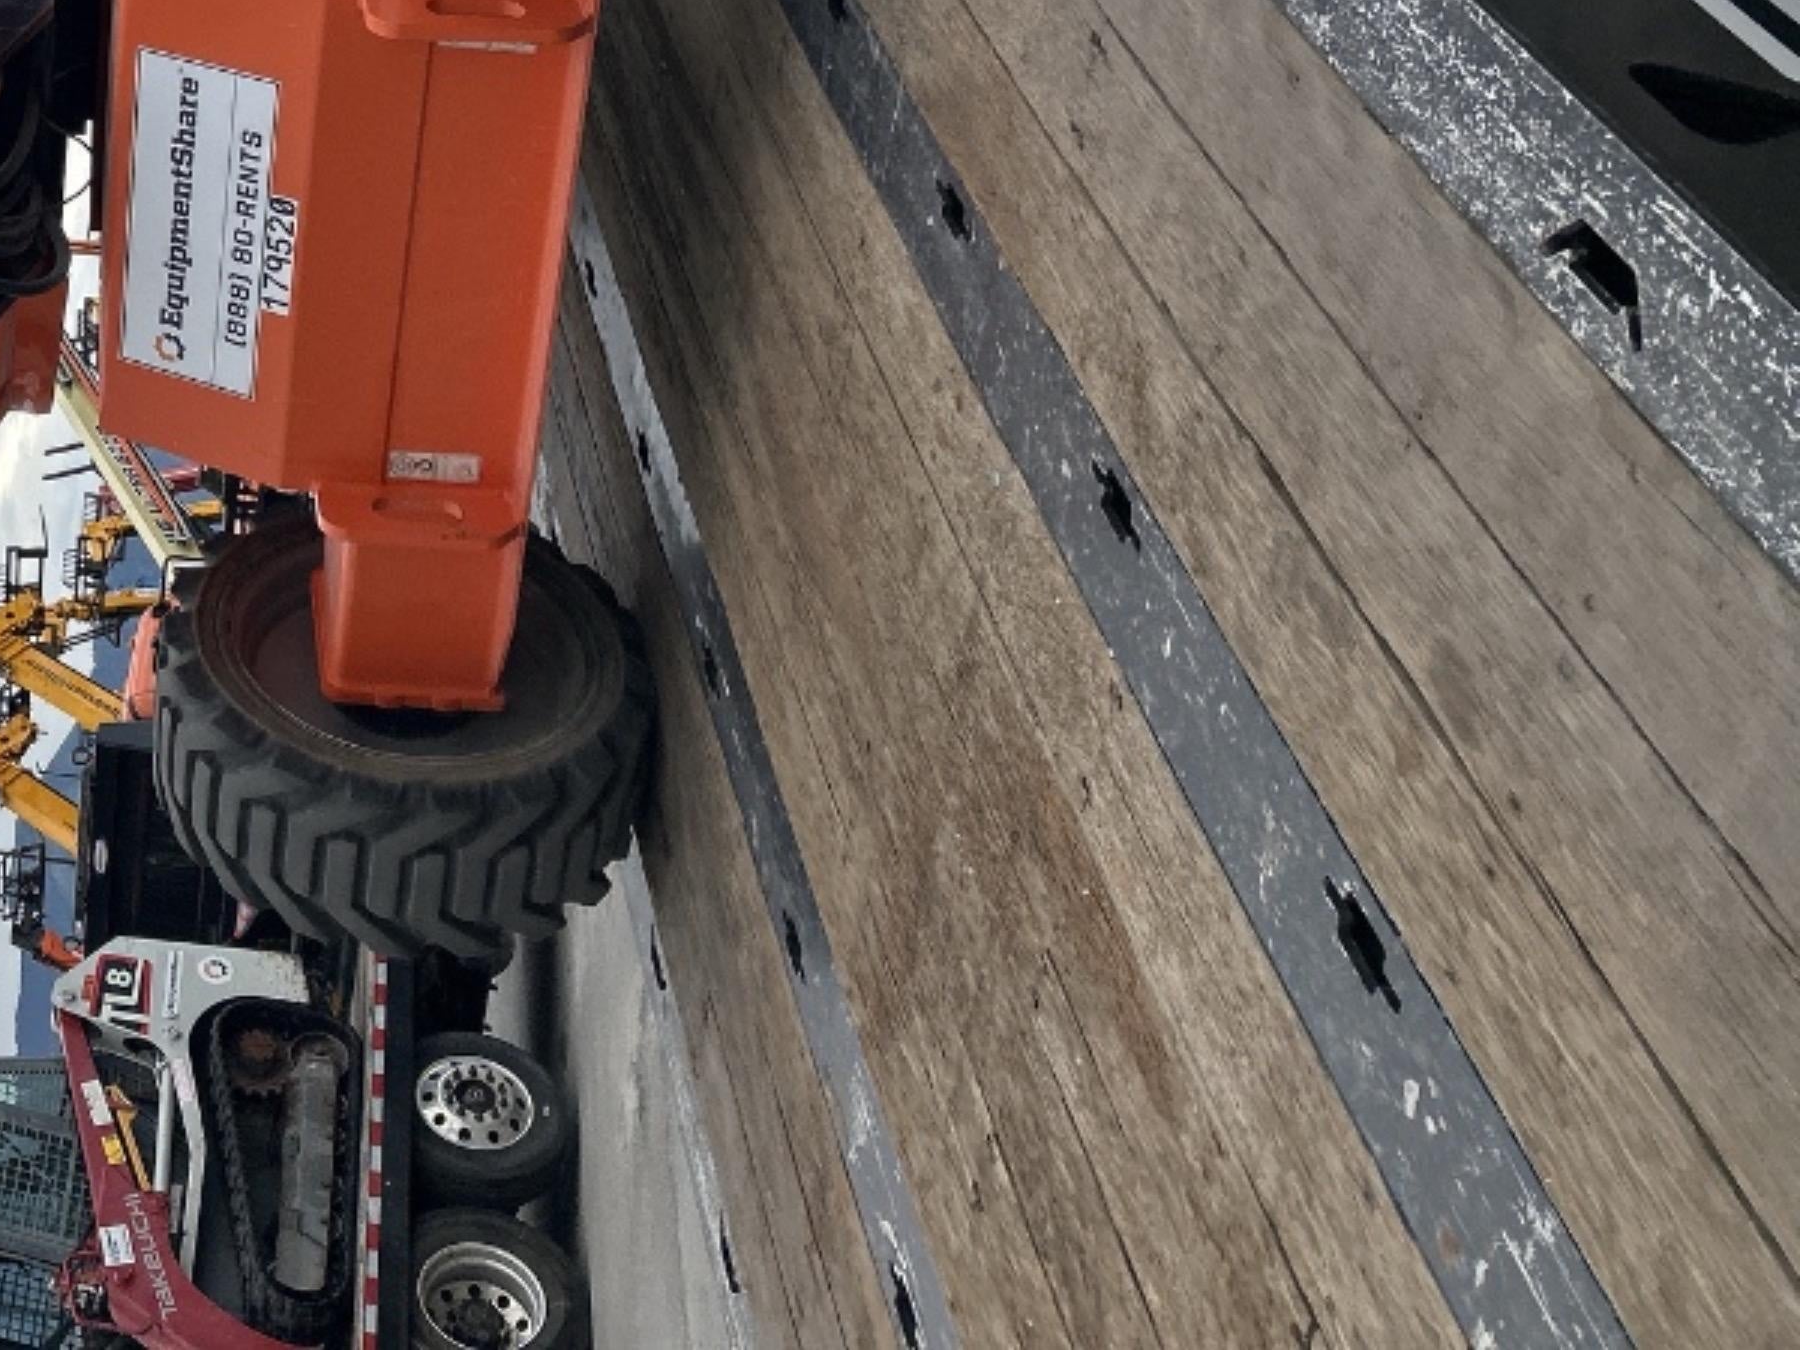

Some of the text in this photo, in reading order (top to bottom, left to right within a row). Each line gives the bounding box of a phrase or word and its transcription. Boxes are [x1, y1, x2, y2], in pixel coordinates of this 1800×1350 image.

[159, 76, 199, 330] EquipmentShare
[223, 129, 262, 348] (888) 80-RENTS
[262, 196, 296, 311] 179520
